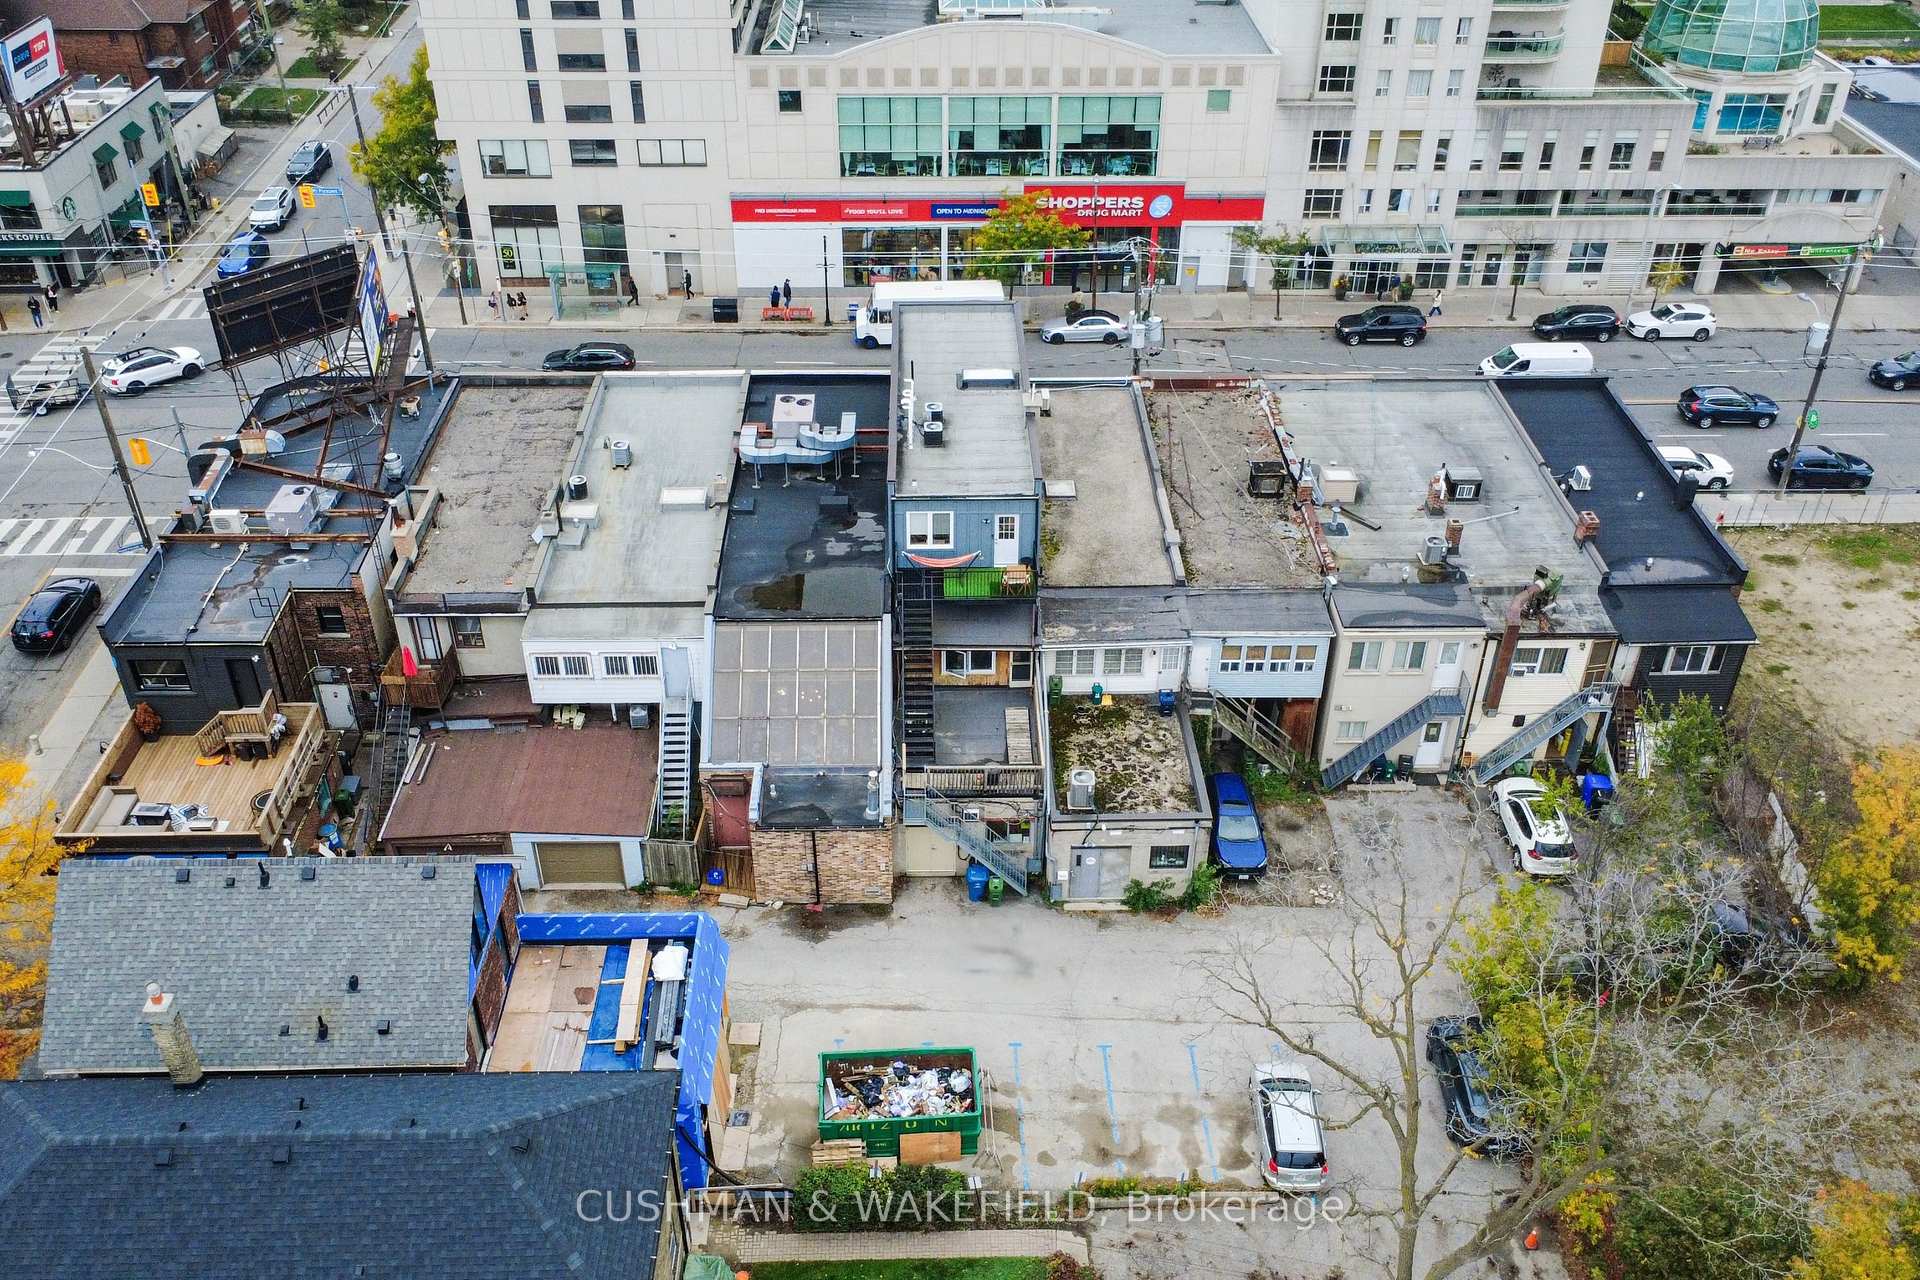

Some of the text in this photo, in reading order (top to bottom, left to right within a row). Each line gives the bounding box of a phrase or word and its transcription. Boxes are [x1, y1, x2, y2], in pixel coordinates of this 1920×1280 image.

[1036, 196, 1145, 209] SHOPPERS
[1077, 209, 1143, 217] DRUG MART
[16, 233, 52, 241] COFFEE
